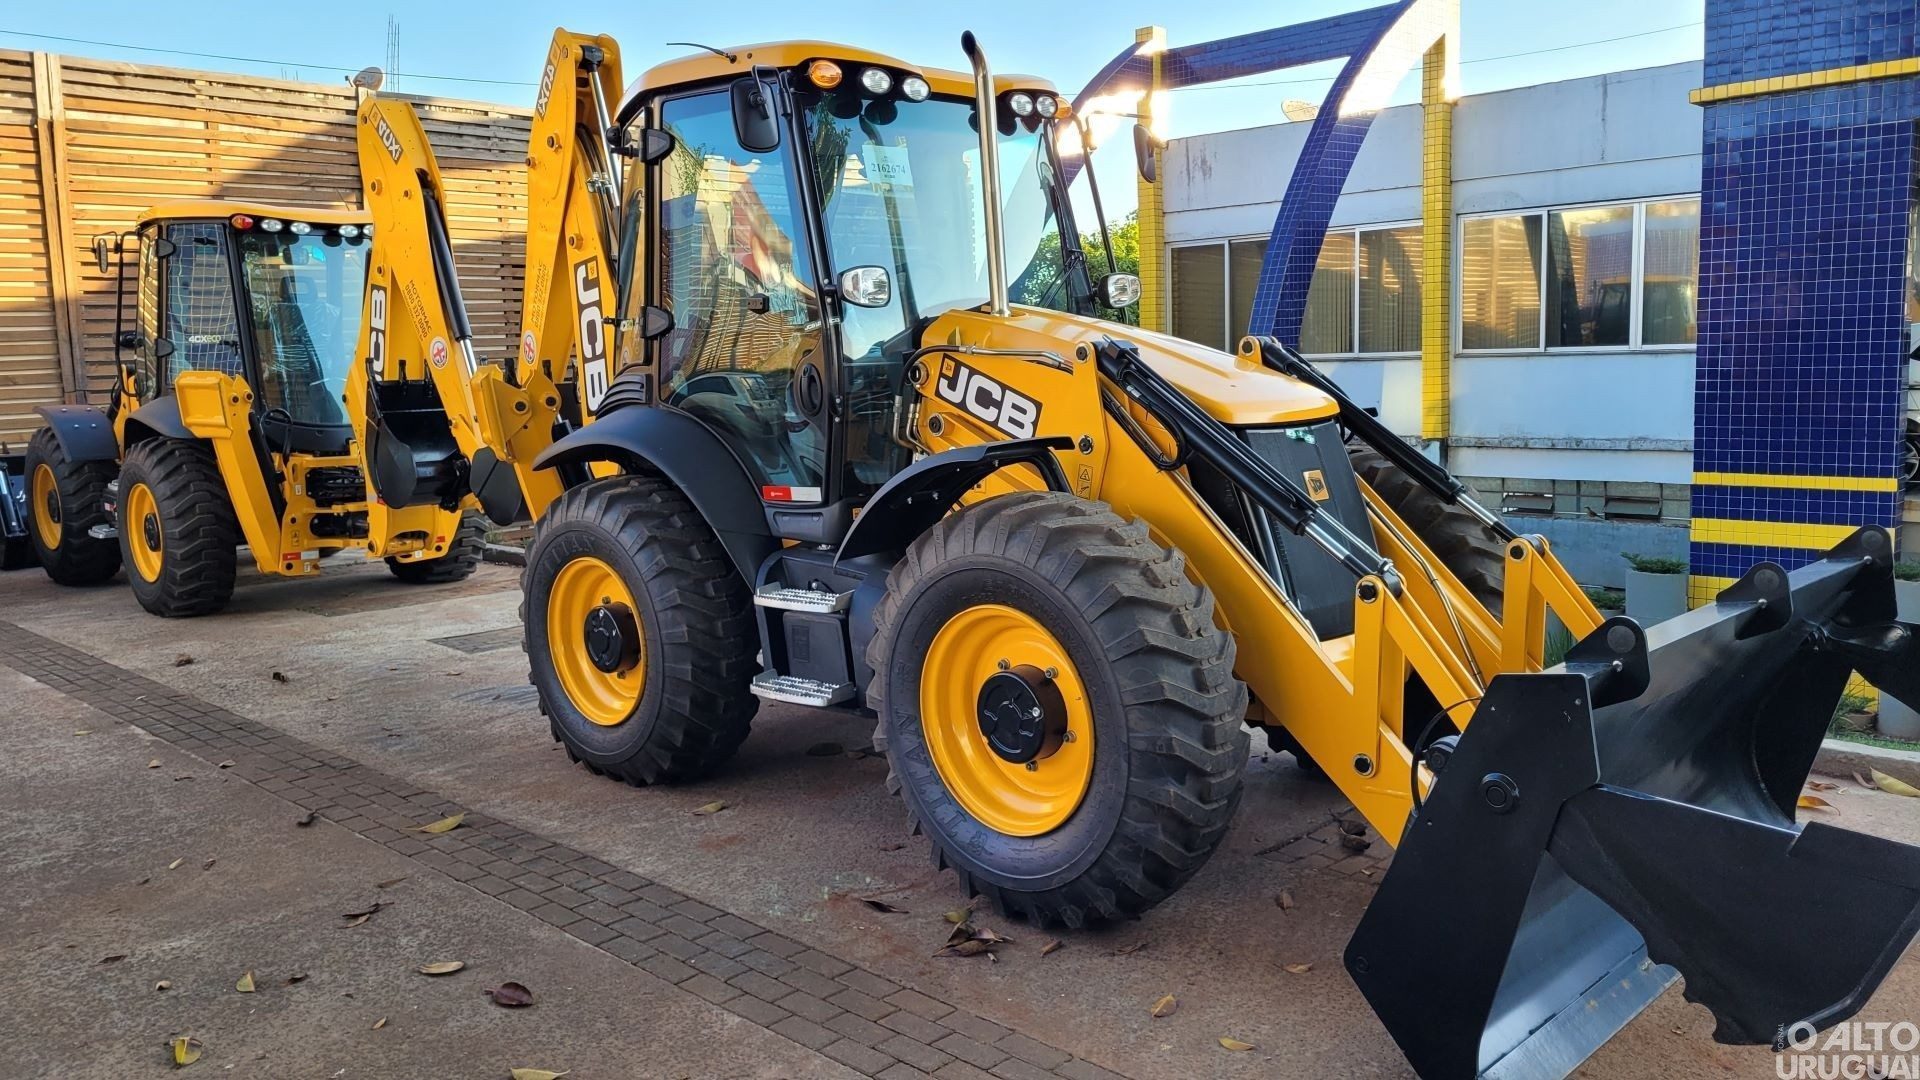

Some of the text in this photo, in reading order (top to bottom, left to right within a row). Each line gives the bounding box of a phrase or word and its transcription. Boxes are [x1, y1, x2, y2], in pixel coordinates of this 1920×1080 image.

[409, 280, 432, 333] MOTORMAC
[576, 264, 609, 412] JCB
[938, 365, 1037, 440] JCB
